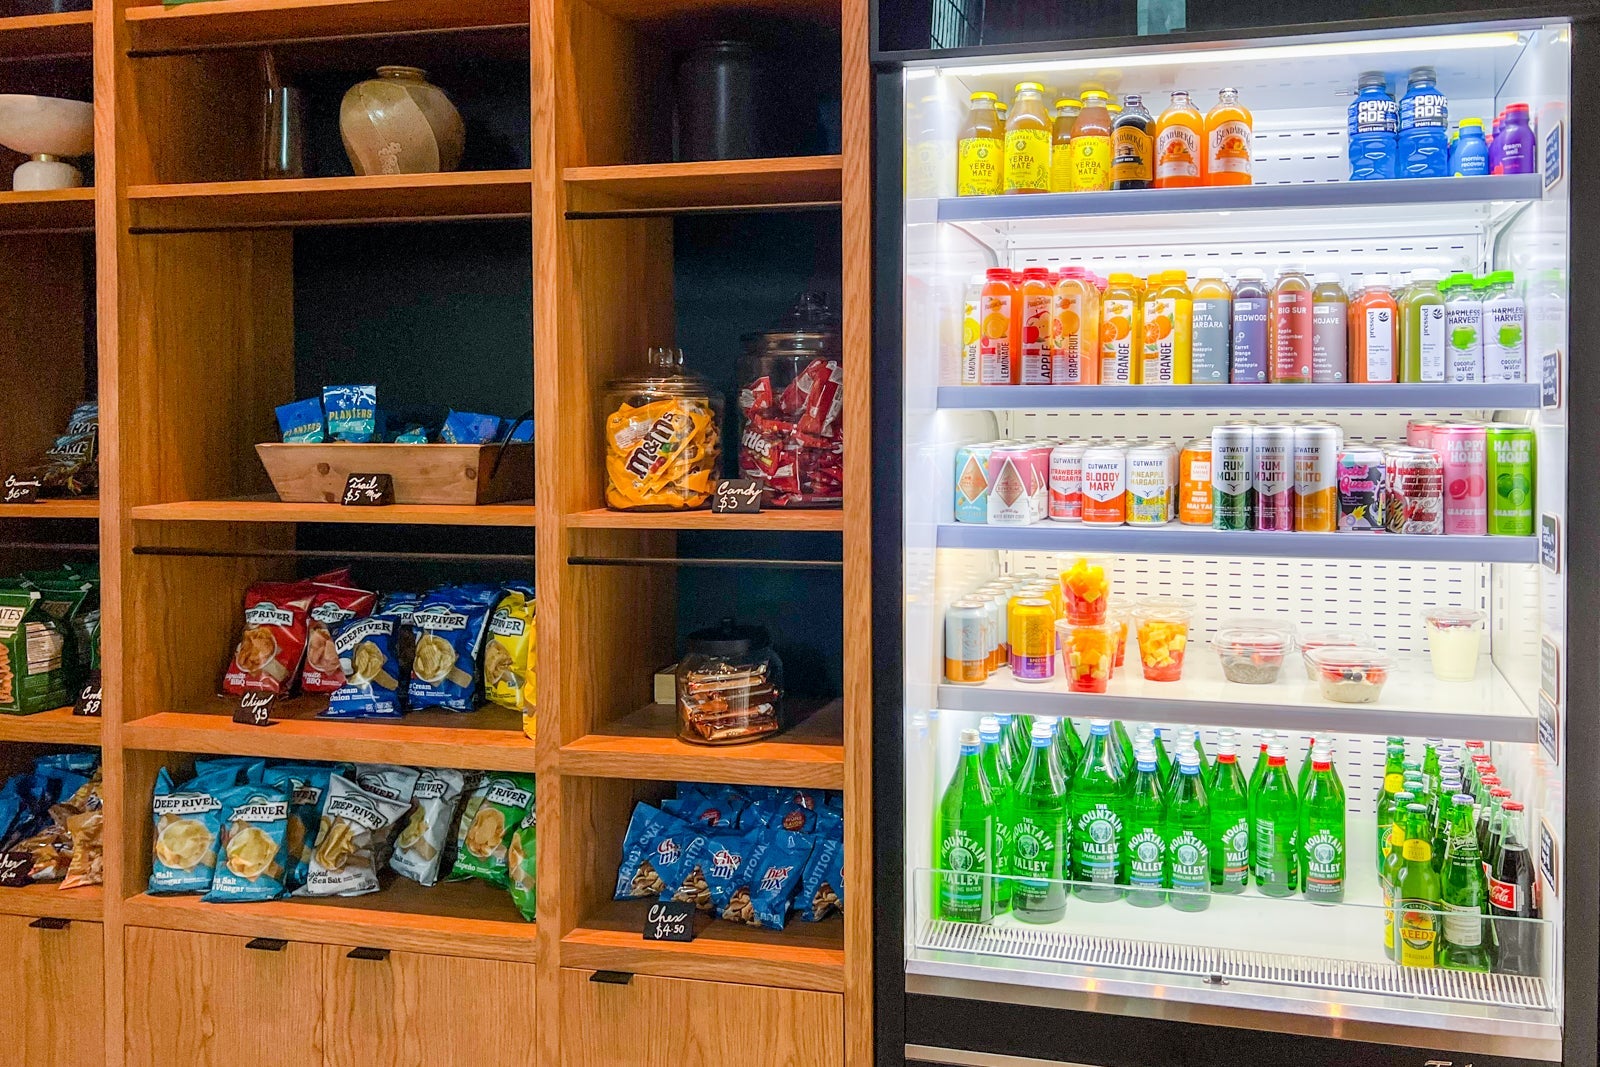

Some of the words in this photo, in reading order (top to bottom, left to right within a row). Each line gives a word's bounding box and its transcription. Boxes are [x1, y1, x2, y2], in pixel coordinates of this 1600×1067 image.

[1358, 111, 1385, 123] ADE
[1415, 106, 1442, 118] ADE
[1009, 155, 1035, 163] YERBA
[969, 162, 995, 171] YERBA
[1011, 162, 1031, 170] MATE
[1078, 168, 1098, 176] MATE
[1278, 306, 1291, 314] BIG
[1292, 306, 1307, 314] SUR
[1446, 309, 1480, 318] HARMLESS
[1313, 317, 1340, 325] MOJAVE
[1368, 311, 1376, 338] pressed
[1422, 308, 1430, 336] pressed
[1449, 315, 1478, 325] HARVEST
[1068, 333, 1078, 378] GRAPEFRUIT
[1159, 342, 1172, 381] ORANGE
[1117, 343, 1129, 381] ORANGE
[328, 409, 372, 421] PLANTERS
[1447, 439, 1485, 451] HAPPY
[1451, 451, 1482, 463] HOUR
[1497, 451, 1529, 463] HOUR
[1223, 461, 1244, 471] RUM
[1260, 461, 1281, 471] RUM
[1295, 461, 1314, 471] RUM
[1086, 472, 1120, 482] BLOODY
[1217, 471, 1250, 481] MOJITO
[1254, 471, 1286, 481] MOJITO
[349, 476, 378, 489] Trail
[1089, 482, 1116, 491] MARY
[344, 490, 361, 506] $5
[717, 481, 763, 504] Candy
[717, 496, 738, 513] $3
[430, 614, 464, 627] RIVER
[336, 626, 358, 651] DEEP
[356, 620, 390, 636] RIVER
[83, 700, 101, 714] $8
[254, 708, 268, 723] $3
[495, 788, 526, 803] RIVER
[154, 799, 180, 809] DEEP
[181, 796, 219, 808] RIVER
[249, 805, 285, 816] RIVER
[352, 804, 383, 829] RIVER
[1078, 809, 1123, 833] MOUNTAIN
[941, 834, 987, 864] MOUNTAIN
[1082, 841, 1120, 854] VALLEY
[1128, 833, 1166, 853] MOUNTAIN
[1169, 834, 1208, 857] MOUNTAIN
[1304, 834, 1343, 855] MOUNTAIN
[803, 838, 838, 898] RADITIONA
[1013, 857, 1048, 871] VALLEY
[1131, 860, 1163, 871] VALLEY
[1172, 862, 1205, 874] VALLEY
[1308, 861, 1341, 873] VALLEY
[155, 870, 173, 878] Salt
[221, 876, 237, 884] Salt
[312, 876, 327, 884] Sea
[328, 876, 342, 884] Salt
[942, 873, 980, 886] VALLEY
[216, 883, 246, 893] Vinegar
[647, 904, 688, 924] Chex
[1401, 928, 1435, 942] REED'S
